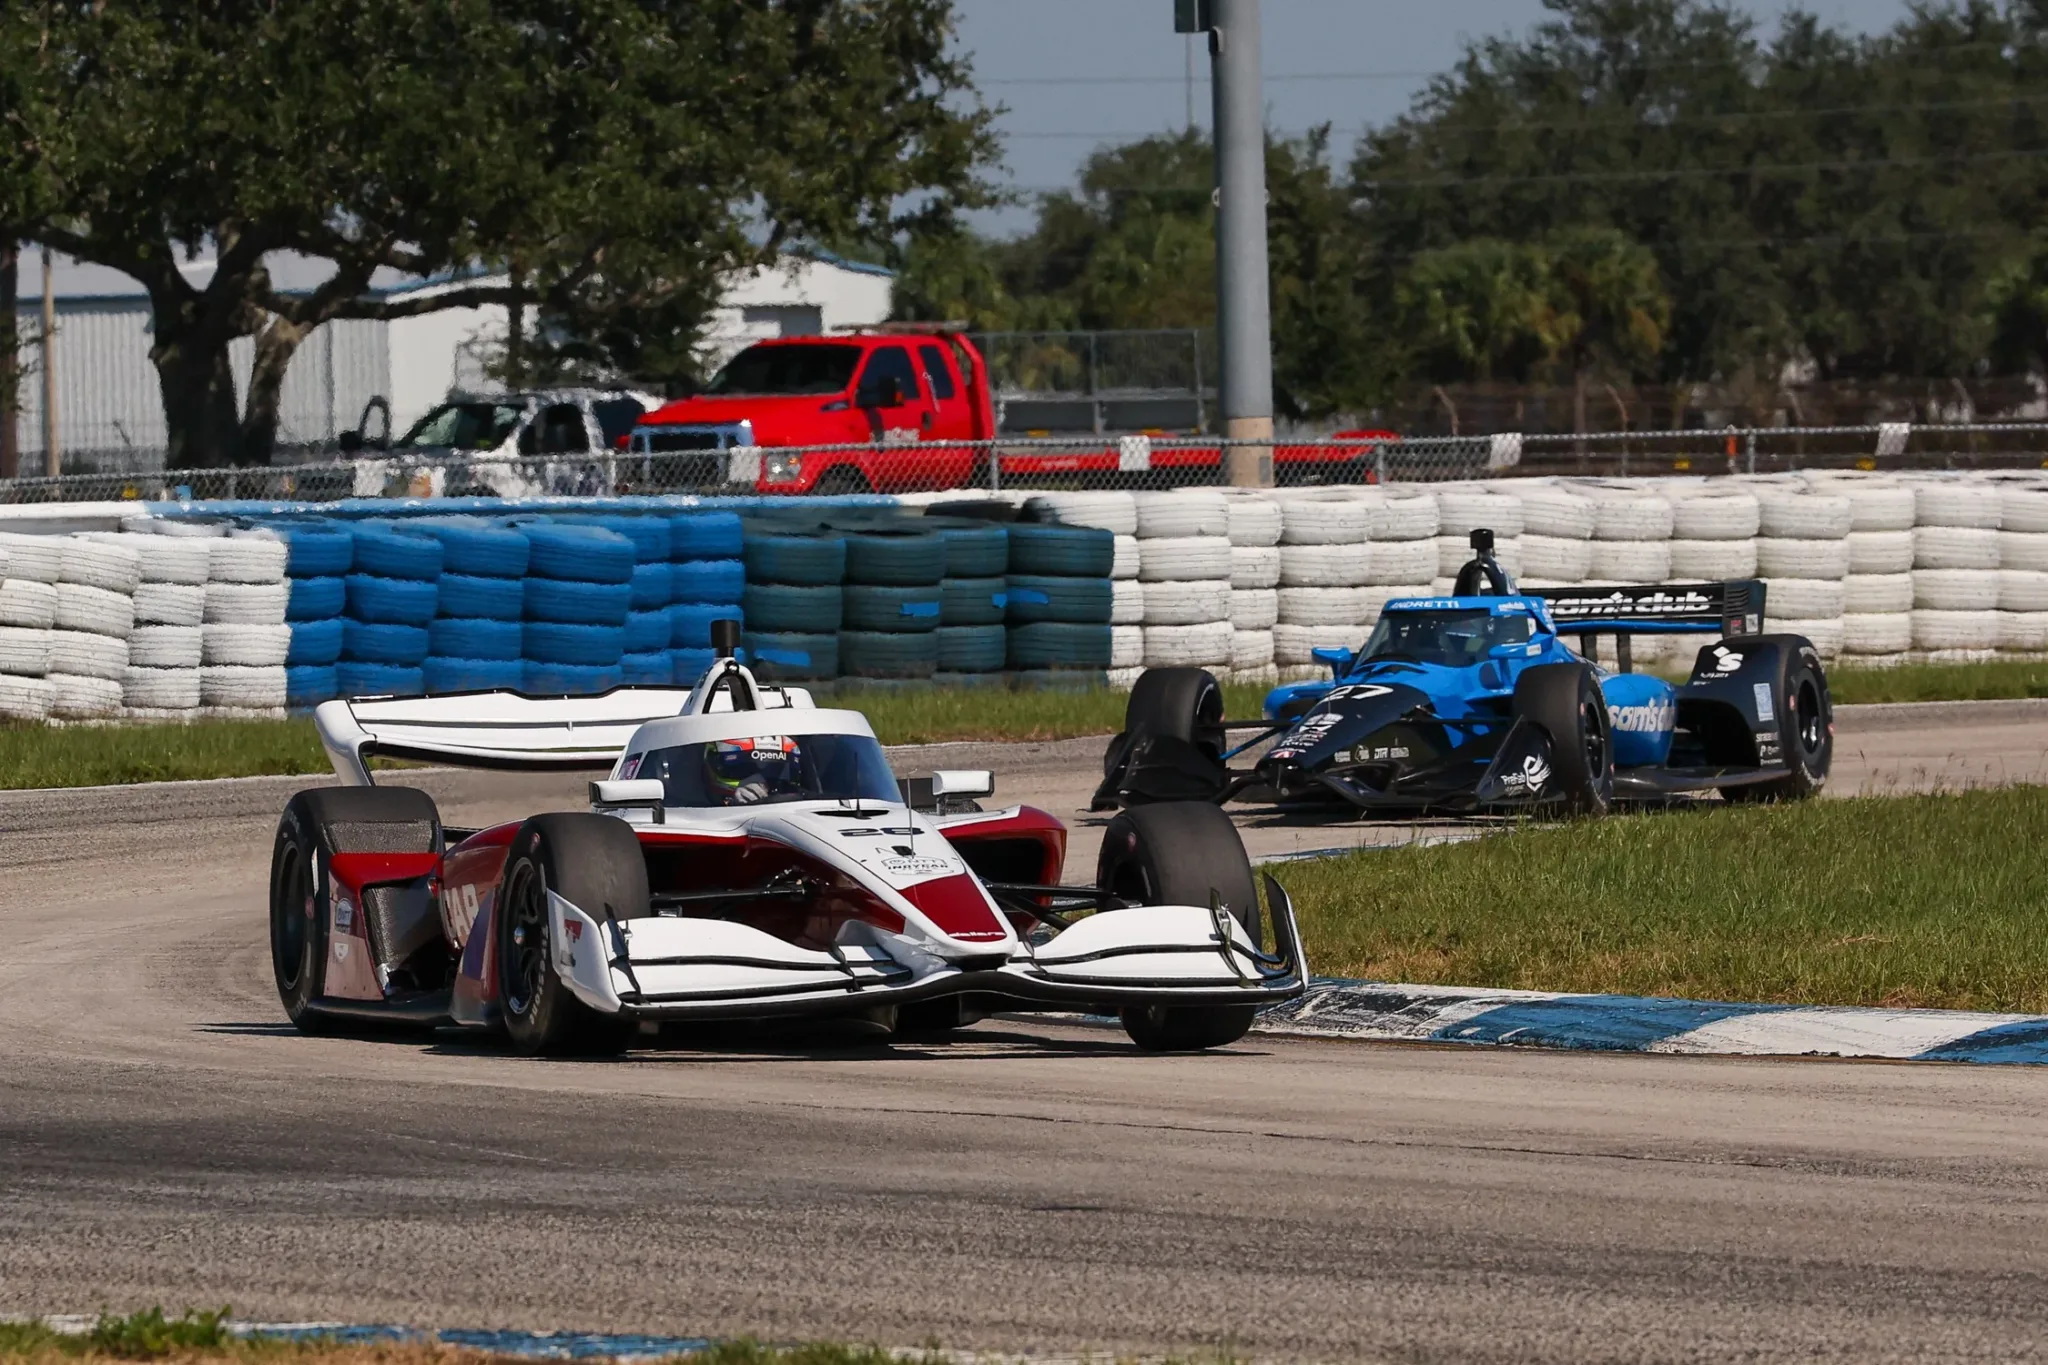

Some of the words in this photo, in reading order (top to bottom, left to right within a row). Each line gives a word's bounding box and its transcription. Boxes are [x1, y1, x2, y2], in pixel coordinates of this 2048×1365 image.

[1391, 600, 1460, 609] ANDRETTI
[1635, 591, 1711, 612] club
[1318, 684, 1394, 704] 27
[751, 750, 787, 761] OpenAI
